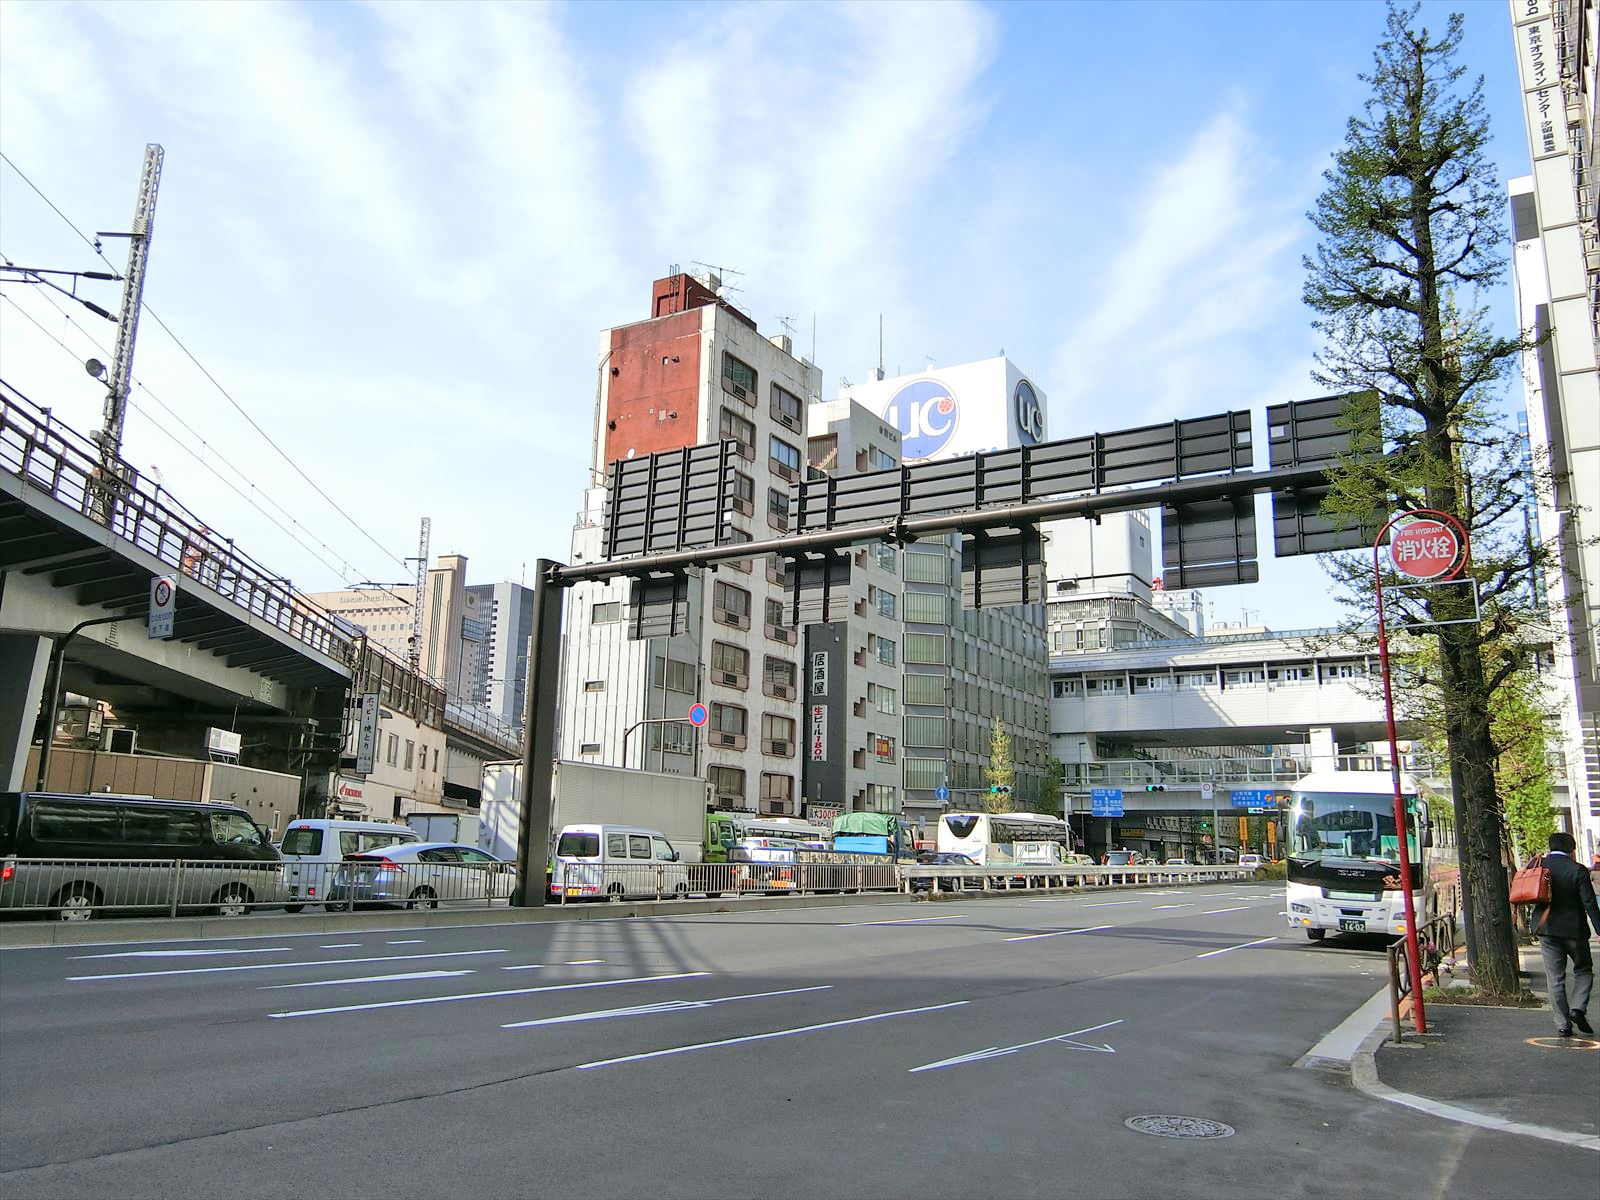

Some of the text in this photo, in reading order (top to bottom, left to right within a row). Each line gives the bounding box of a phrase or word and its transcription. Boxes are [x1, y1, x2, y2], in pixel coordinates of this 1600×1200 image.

[1415, 527, 1443, 535] HYDRANT
[1397, 536, 1451, 561] 消火栓
[813, 653, 825, 695] 居酒屋
[813, 705, 824, 761] 生ビール180円
